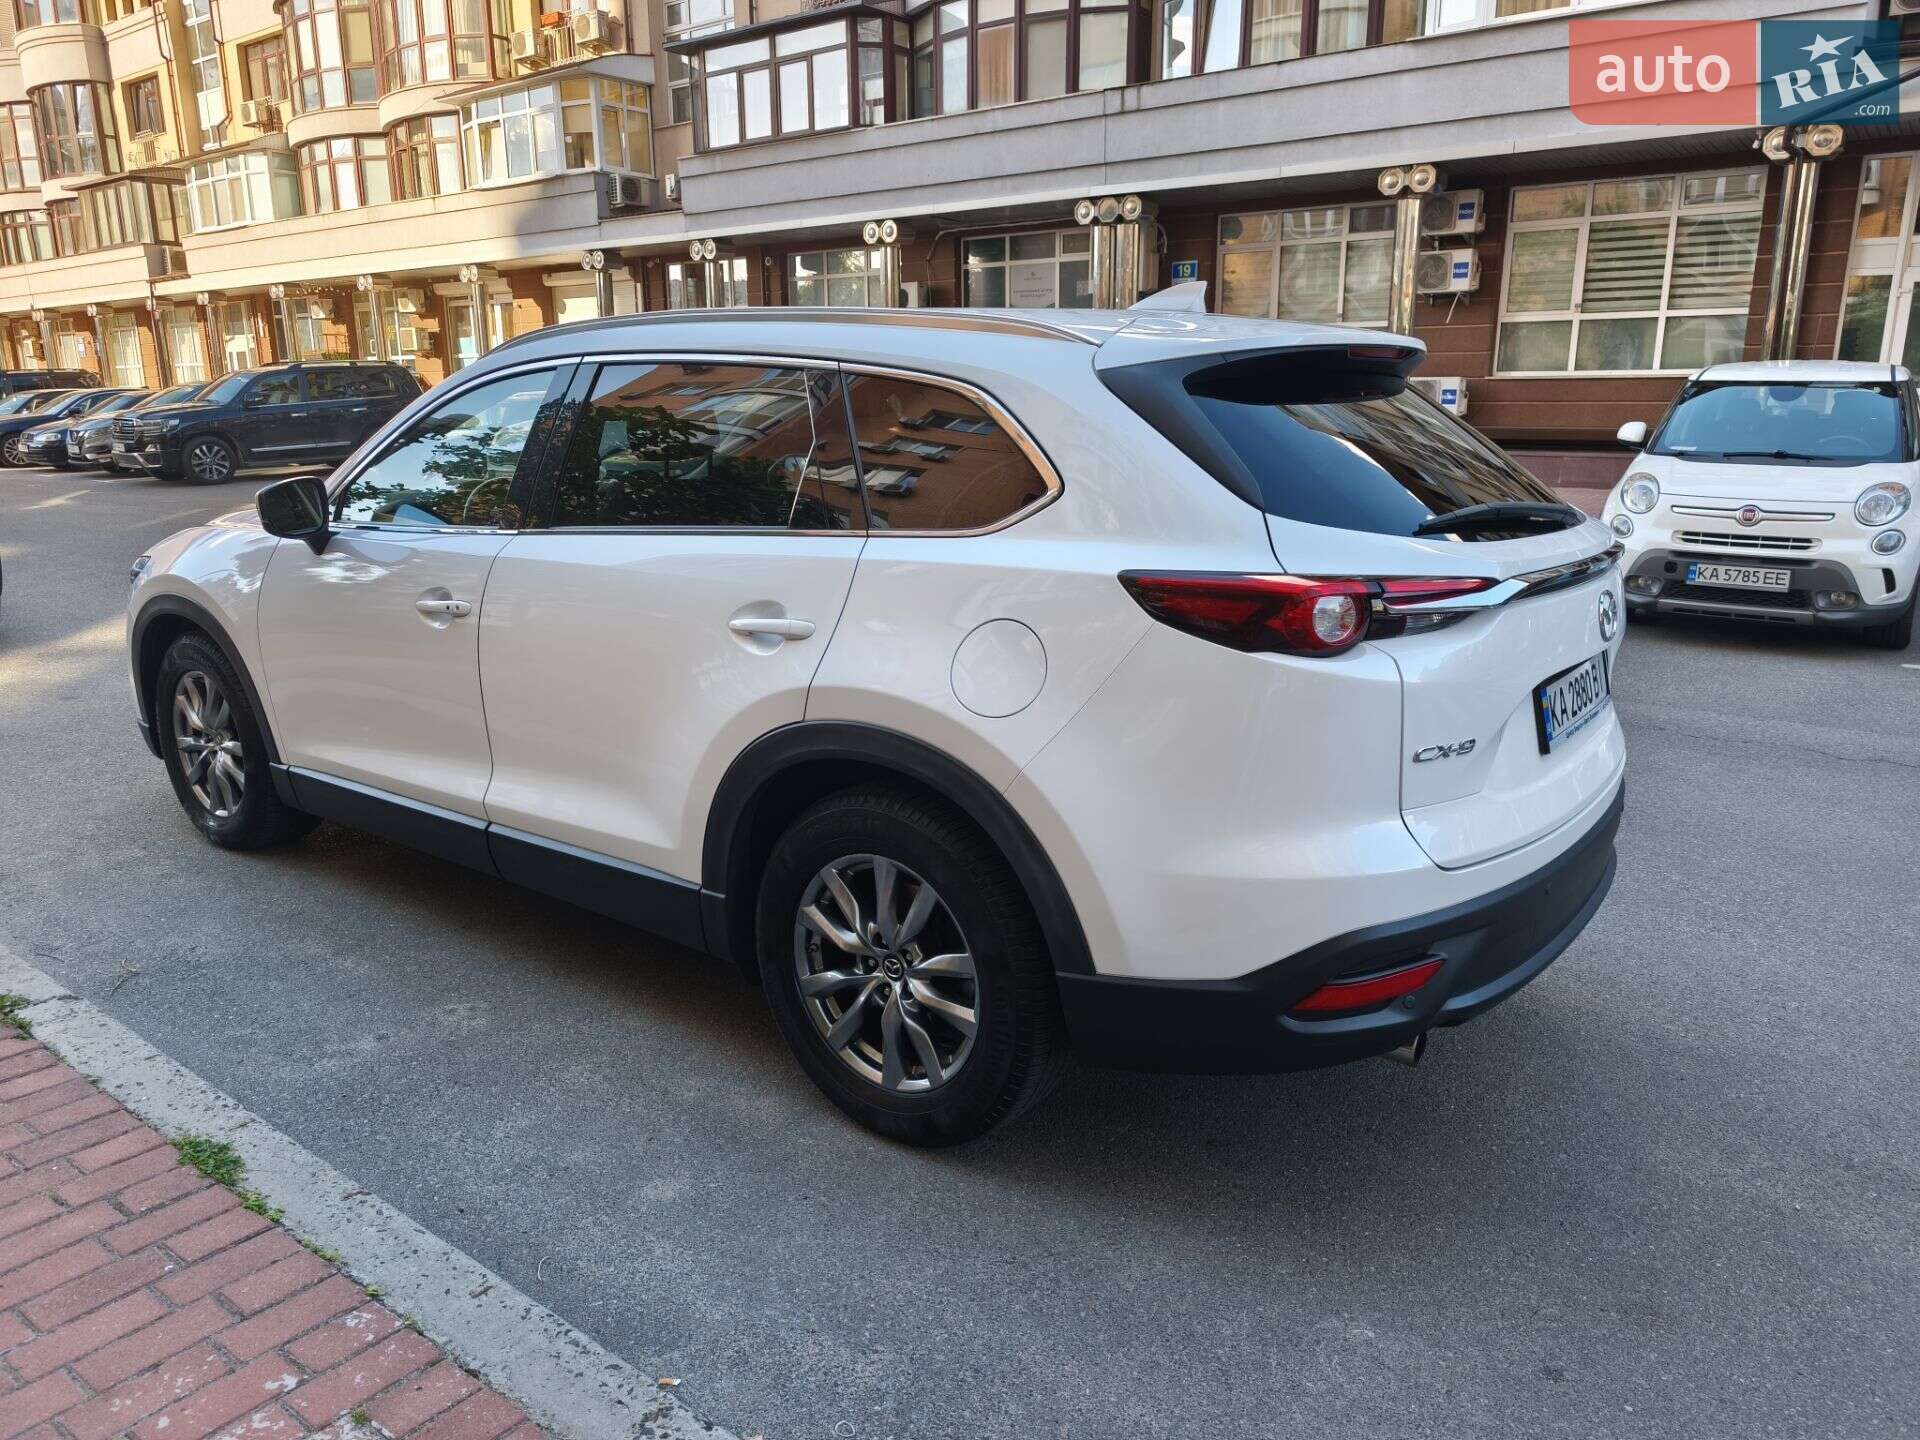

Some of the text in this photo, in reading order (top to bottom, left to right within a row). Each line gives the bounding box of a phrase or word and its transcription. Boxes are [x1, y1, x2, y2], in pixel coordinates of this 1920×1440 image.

[1177, 264, 1191, 277] 19
[1697, 566, 1788, 586] KA 5785 EE
[1549, 686, 1570, 732] KA
[1568, 669, 1593, 718] 2880
[1412, 738, 1476, 763] CX-9
